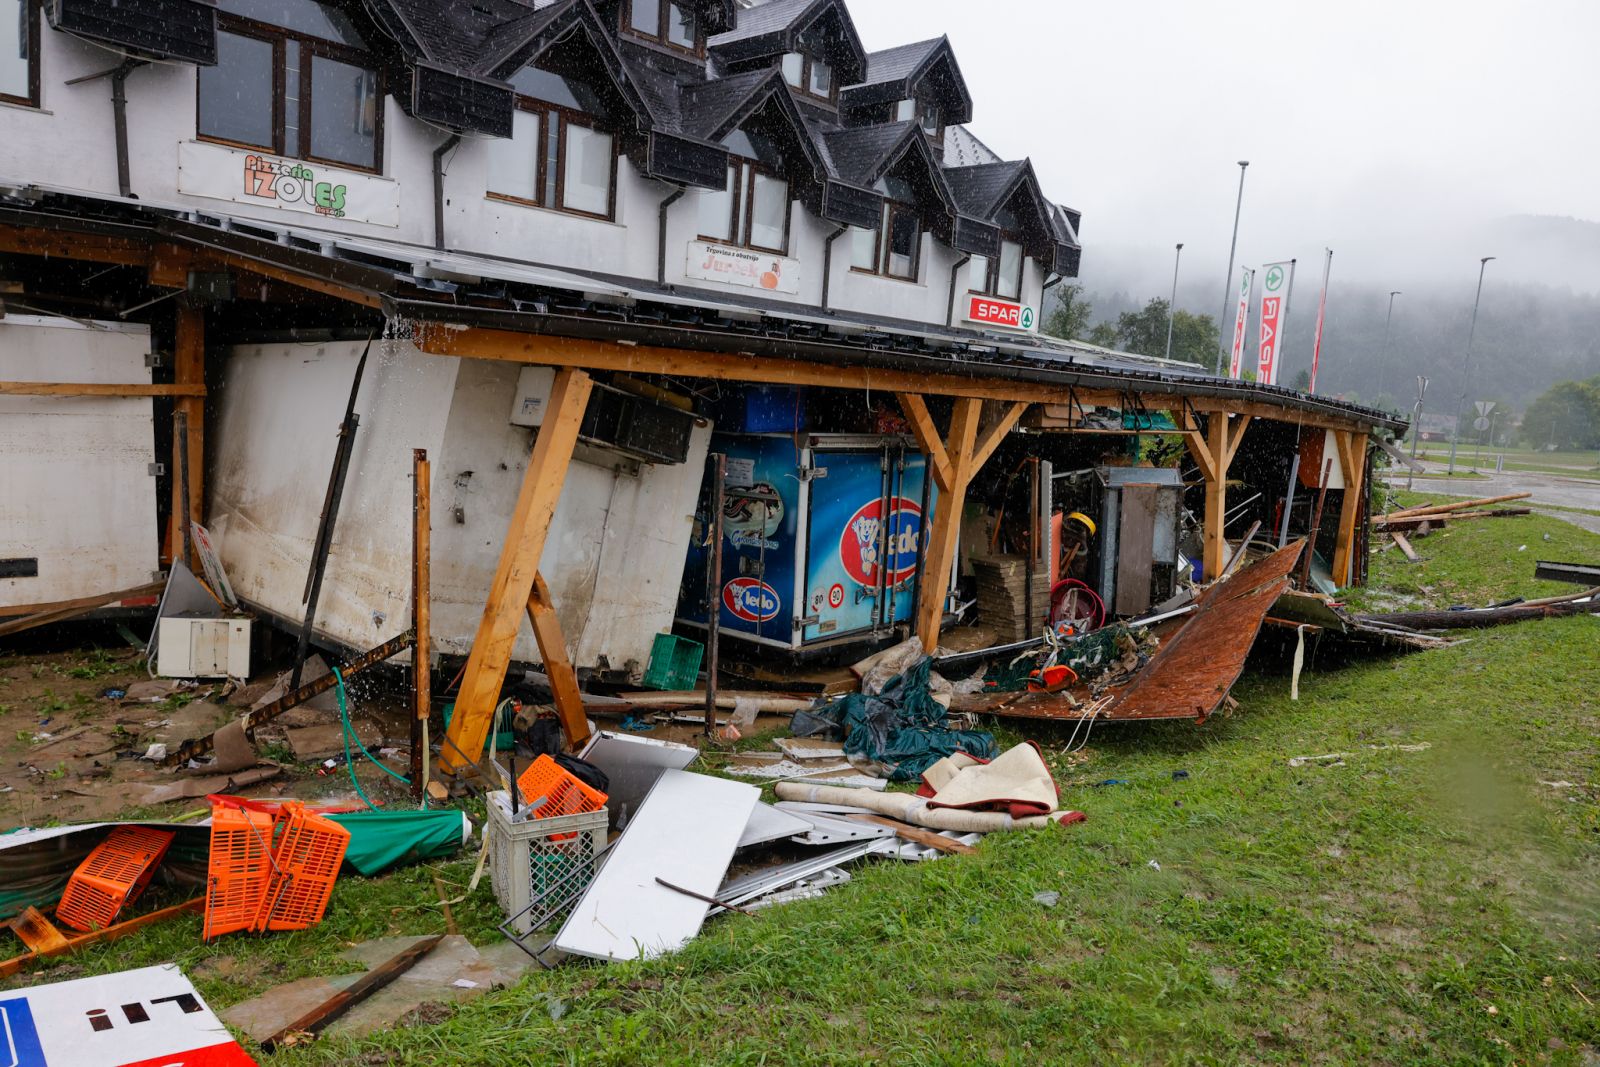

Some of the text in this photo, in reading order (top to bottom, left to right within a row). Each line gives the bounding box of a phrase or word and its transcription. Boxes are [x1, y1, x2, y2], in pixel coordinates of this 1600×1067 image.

[245, 154, 313, 180] Pizzeria
[706, 246, 731, 257] Trgovina
[978, 303, 1019, 322] SPAR
[814, 594, 824, 605] 80
[832, 589, 841, 602] 90
